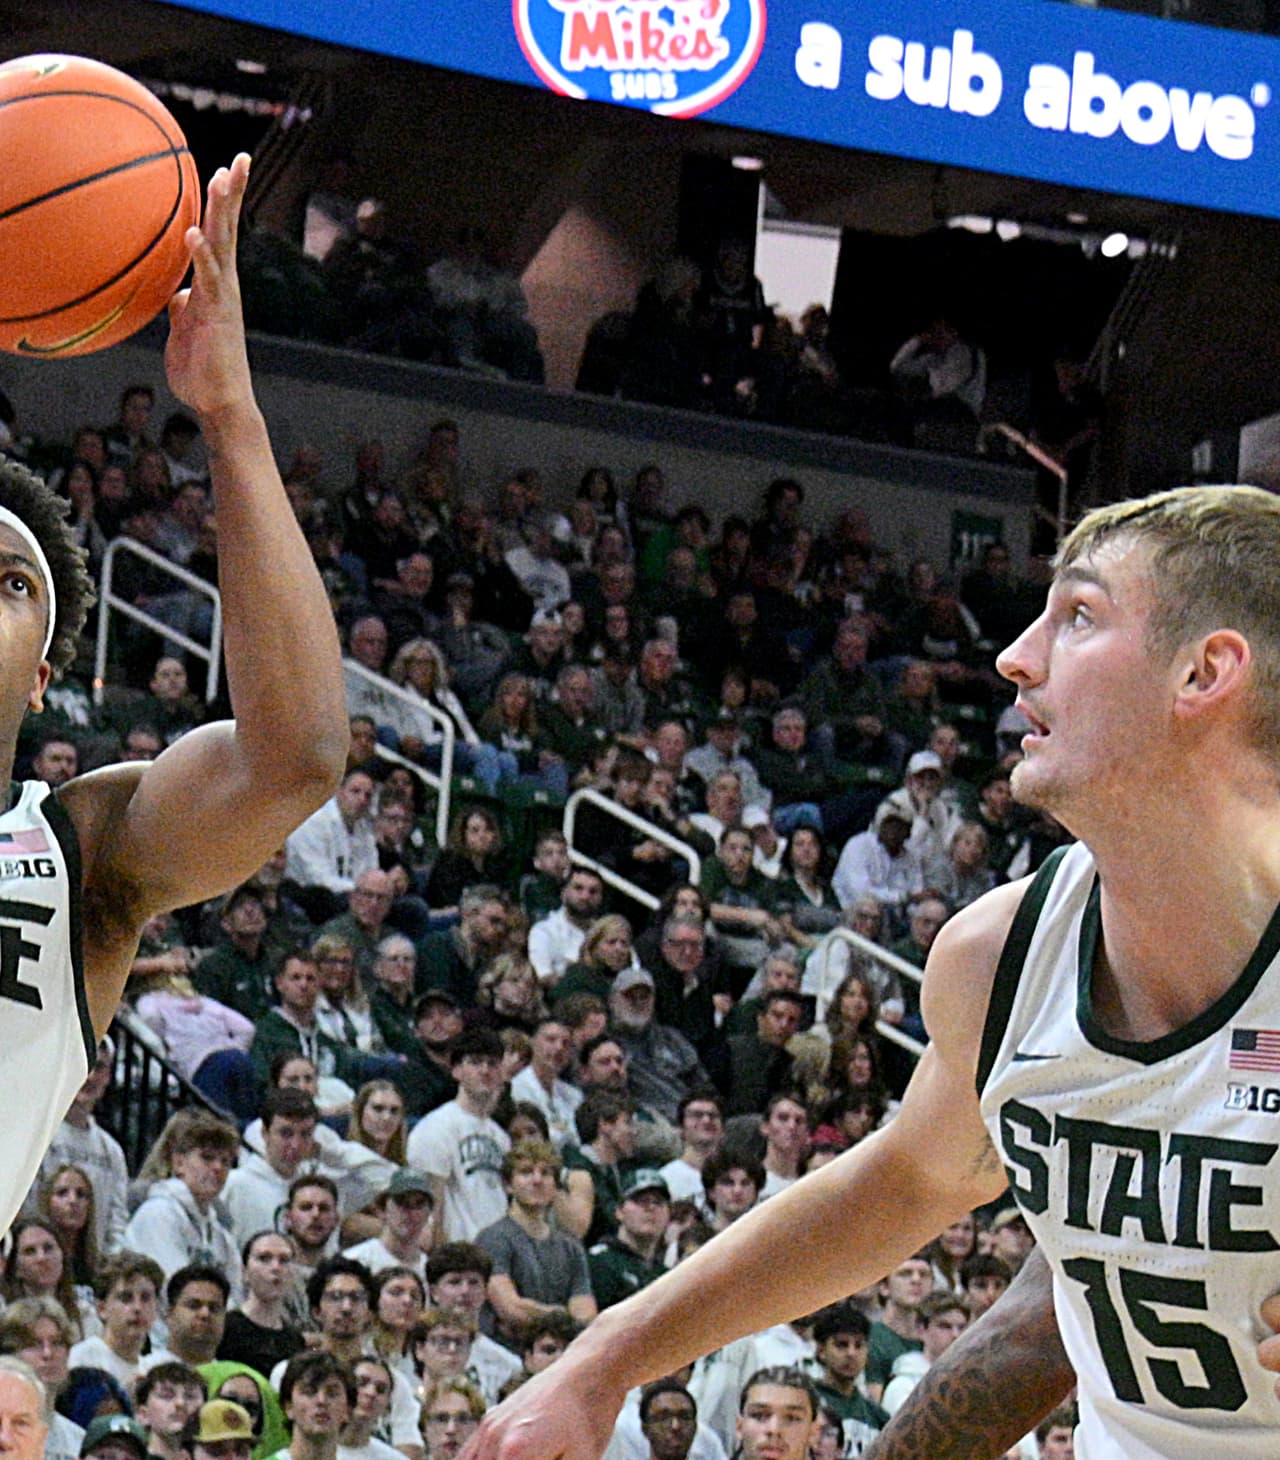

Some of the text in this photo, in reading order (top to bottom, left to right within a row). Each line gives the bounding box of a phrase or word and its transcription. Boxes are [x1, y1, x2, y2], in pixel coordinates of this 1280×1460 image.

[565, 7, 726, 67] Mike's
[610, 71, 678, 101] SUBS
[794, 21, 1257, 161] a sub above
[999, 1098, 1280, 1253] STATE
[1062, 1256, 1248, 1412] 15
